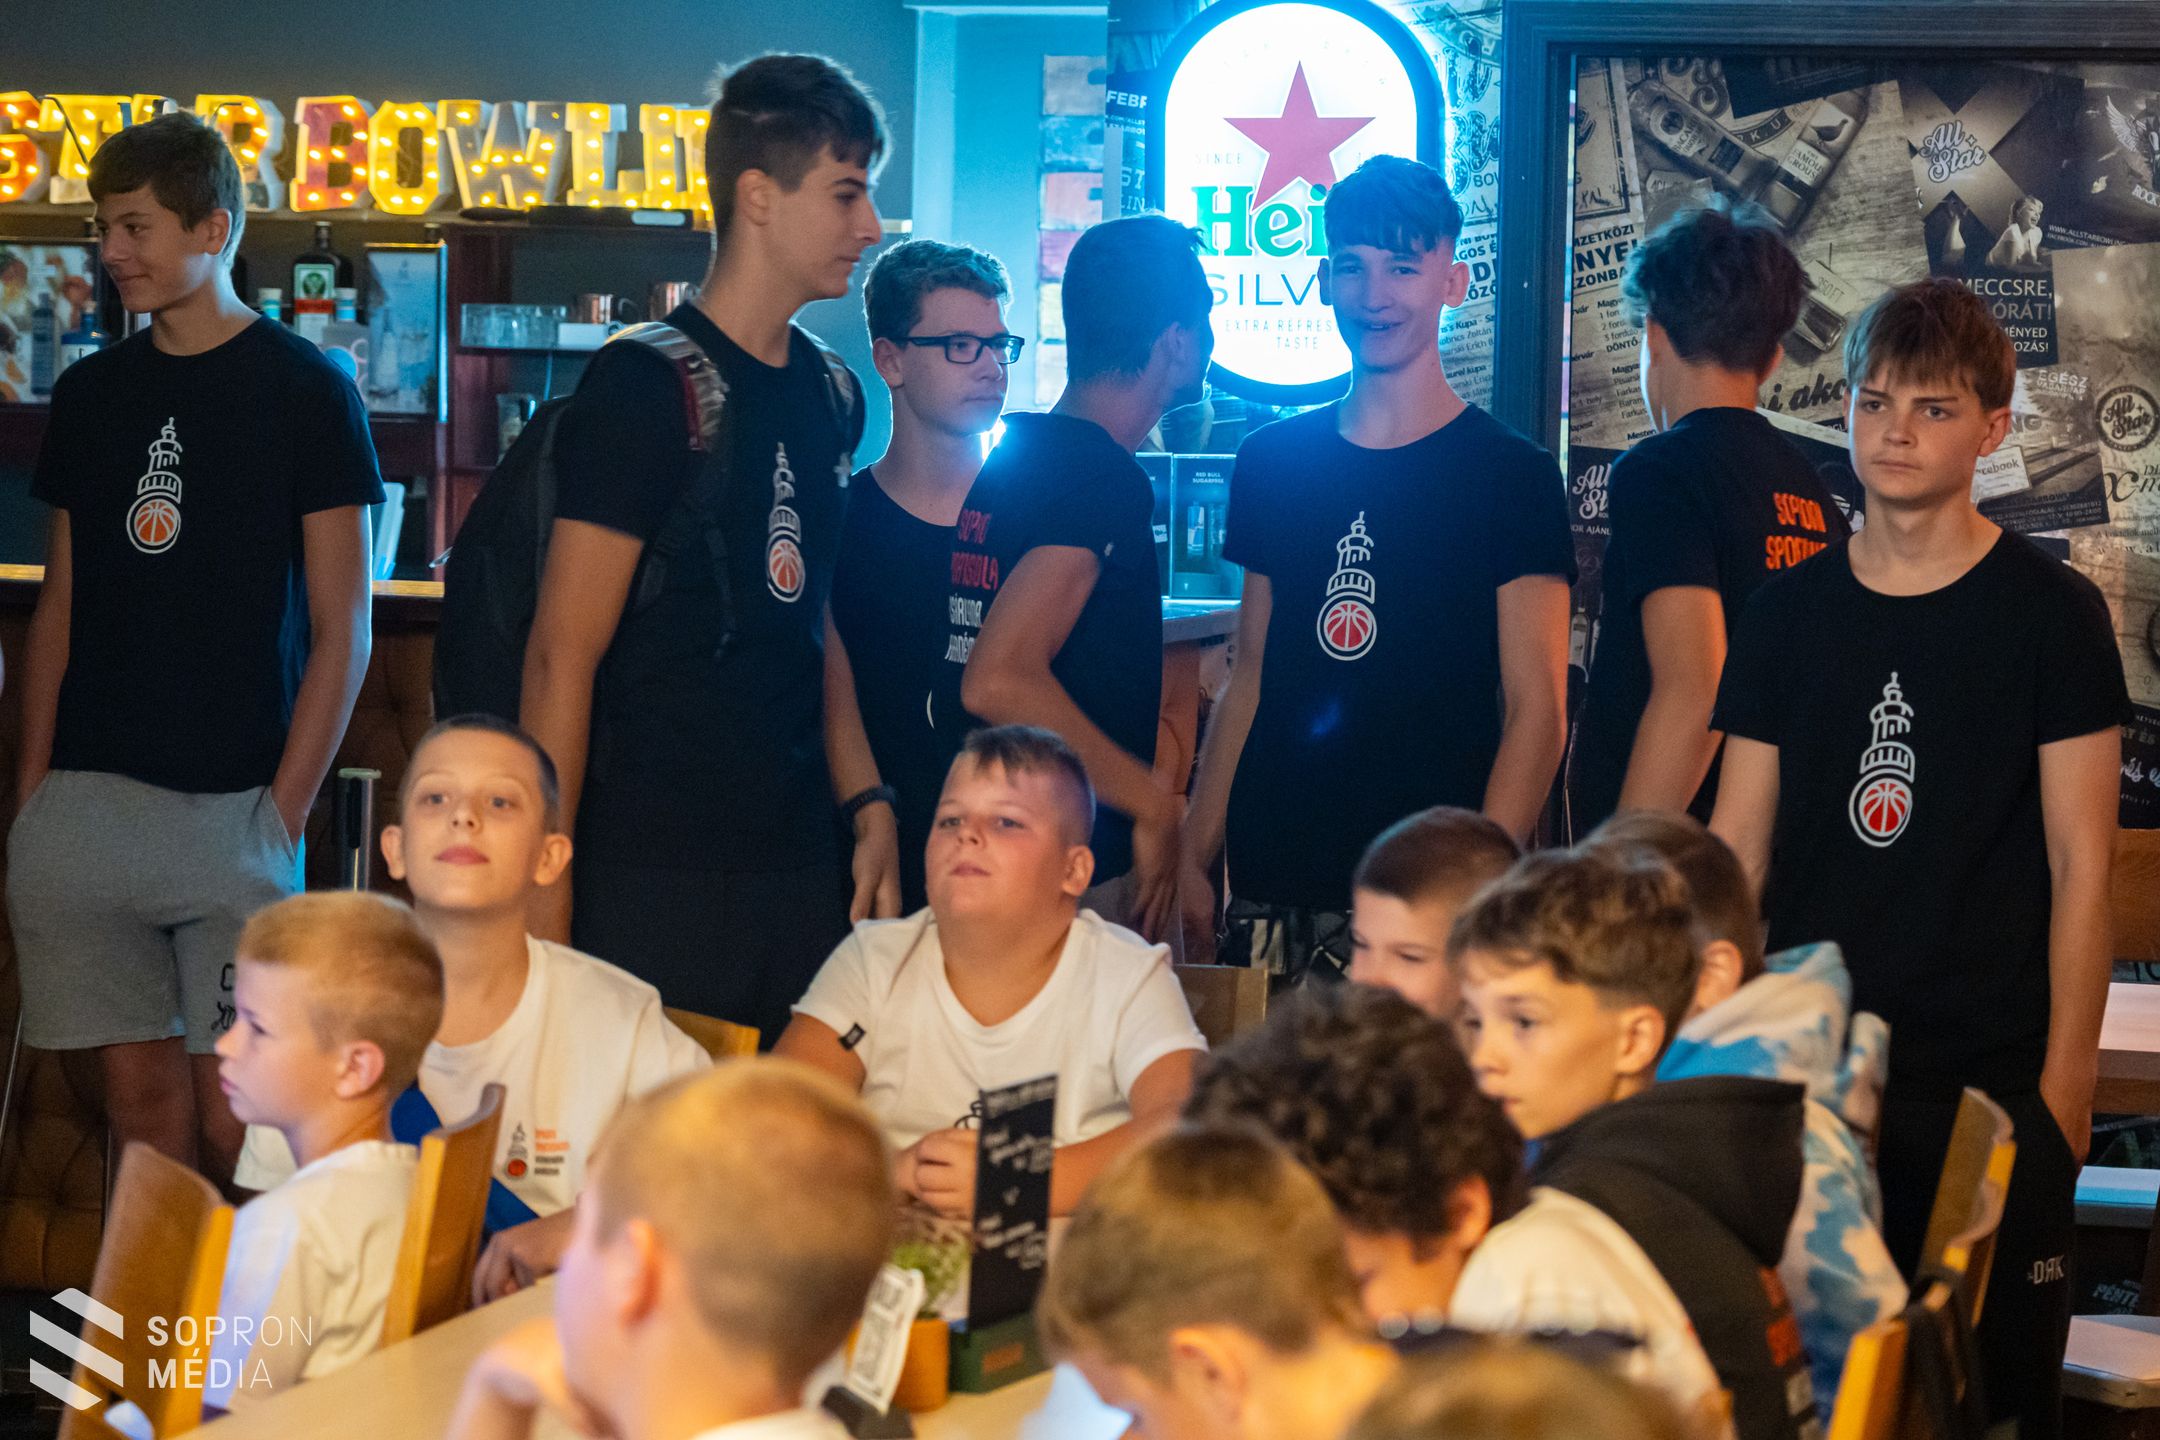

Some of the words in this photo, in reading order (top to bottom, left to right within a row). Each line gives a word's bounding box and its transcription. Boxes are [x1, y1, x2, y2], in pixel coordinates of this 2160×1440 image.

[1919, 119, 1966, 158] All
[1928, 145, 1987, 183] Star
[1205, 273, 1318, 306] SILV
[1992, 298, 2052, 320] ÓRÁT!
[1225, 319, 1269, 333] EXTRA
[1276, 336, 1319, 350] TASTE
[2038, 369, 2089, 389] EGÉSZ
[2103, 394, 2136, 423] All
[2112, 412, 2154, 440] Star
[1976, 458, 2020, 476] cebook
